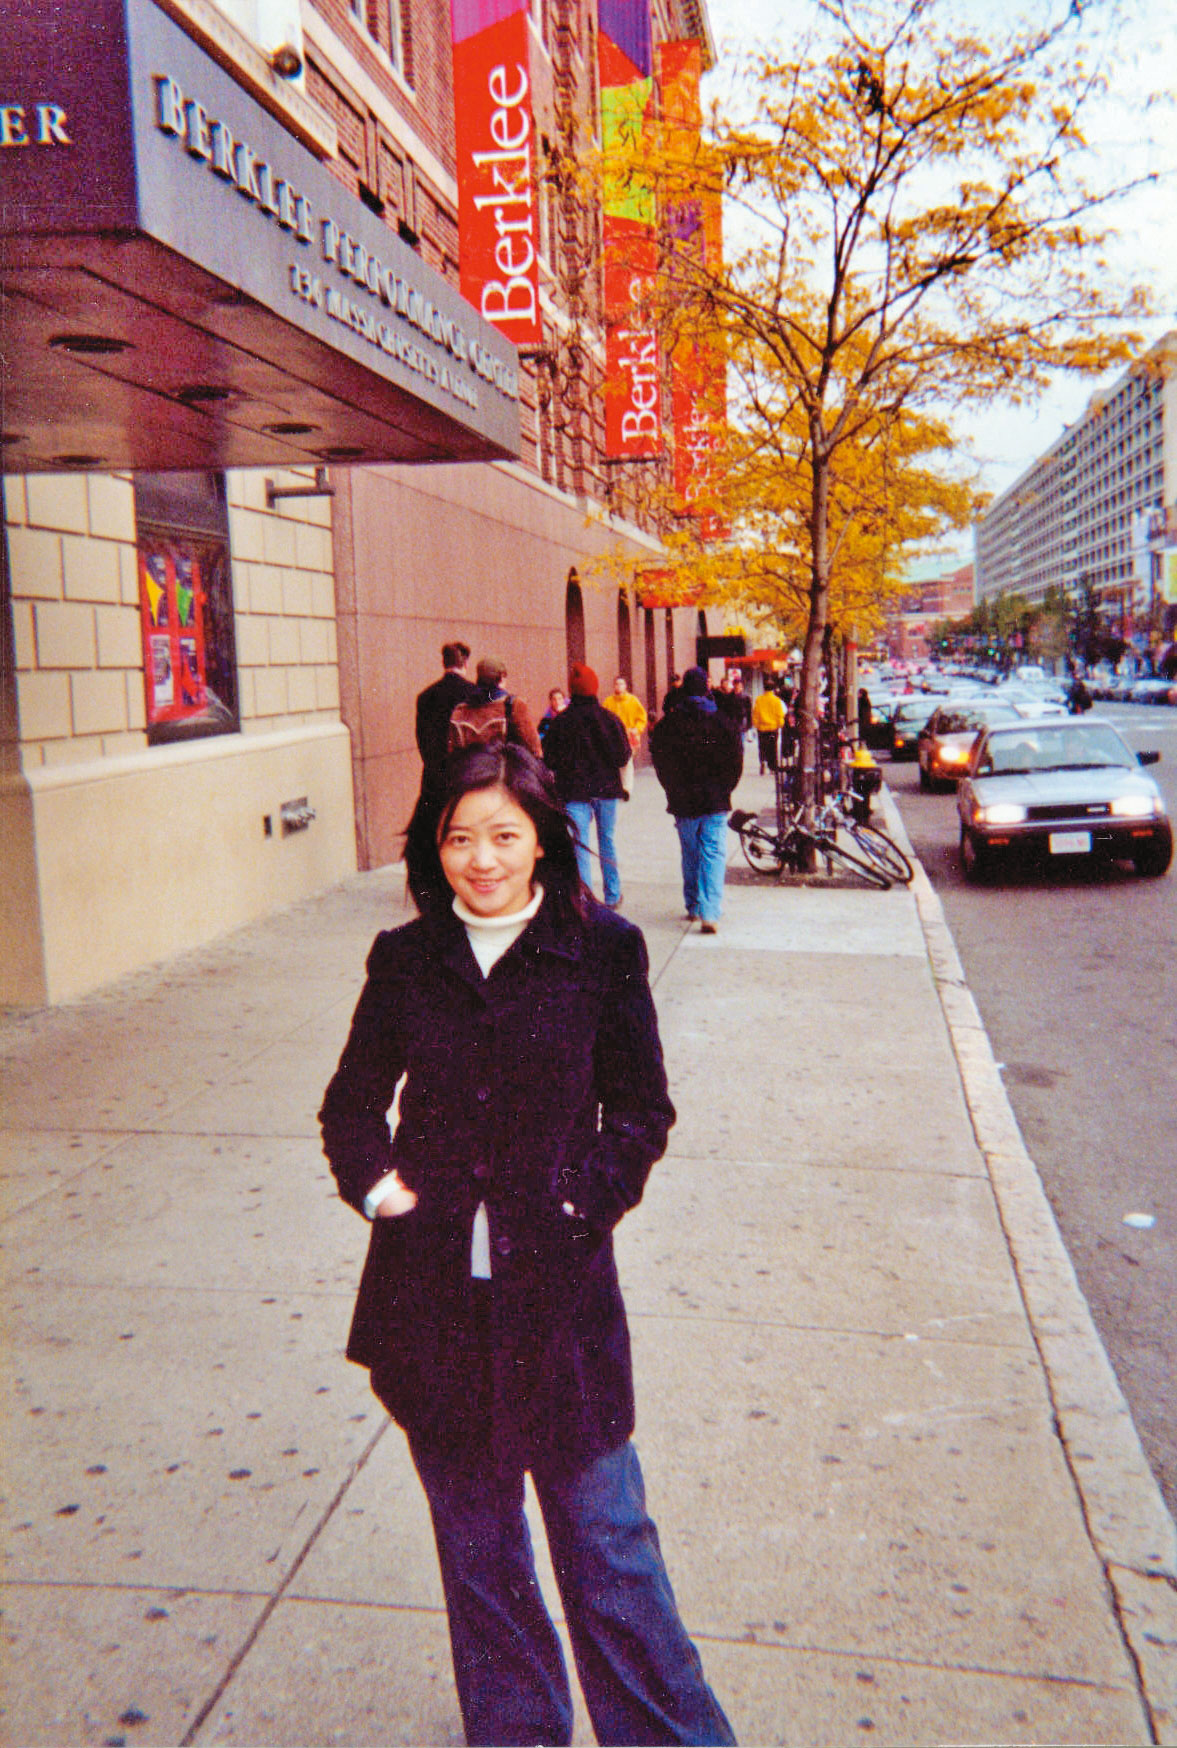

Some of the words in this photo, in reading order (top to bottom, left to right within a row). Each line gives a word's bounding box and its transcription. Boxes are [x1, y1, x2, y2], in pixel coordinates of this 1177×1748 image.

[155, 75, 314, 242] BERKLEE
[321, 218, 467, 363] PERFORMANCE
[472, 63, 537, 327] Berklee
